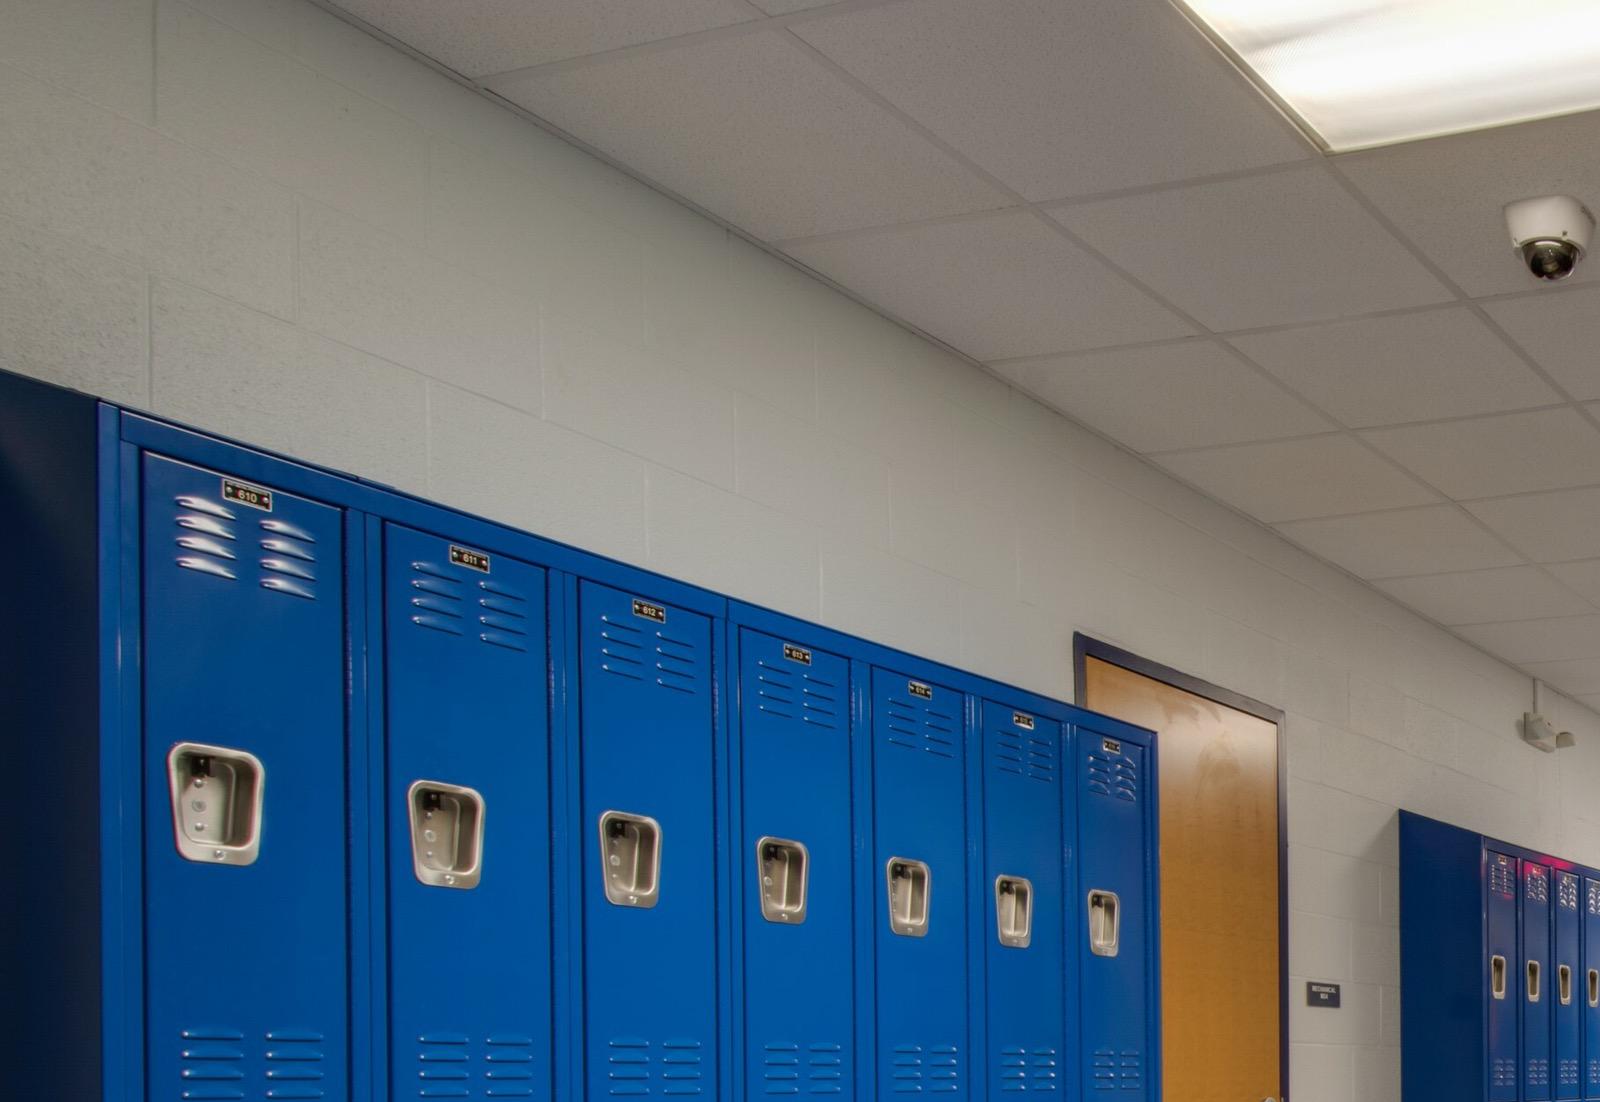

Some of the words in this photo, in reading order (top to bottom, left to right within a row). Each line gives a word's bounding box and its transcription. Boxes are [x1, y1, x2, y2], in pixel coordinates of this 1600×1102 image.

[238, 490, 257, 503] 610
[463, 554, 477, 564] 611
[642, 606, 656, 617] 612
